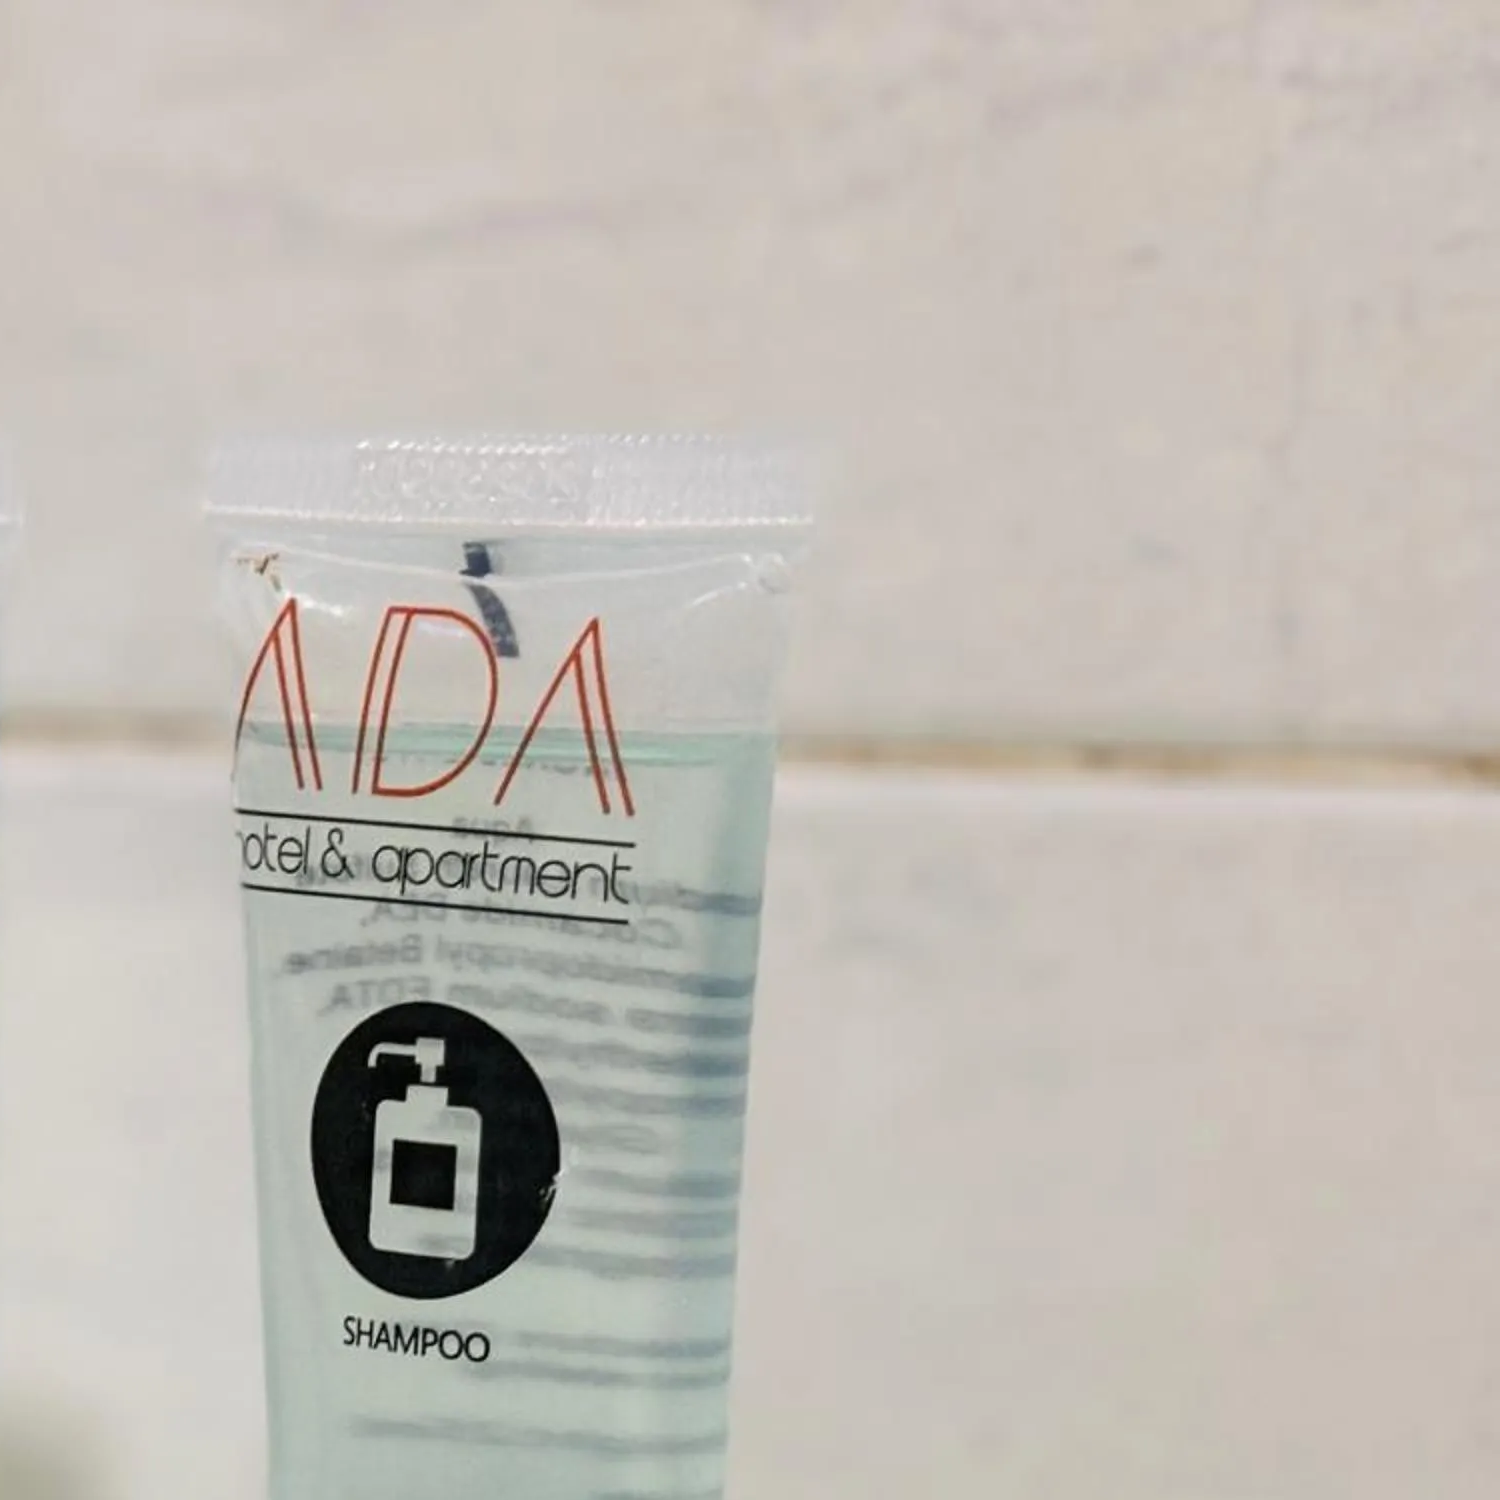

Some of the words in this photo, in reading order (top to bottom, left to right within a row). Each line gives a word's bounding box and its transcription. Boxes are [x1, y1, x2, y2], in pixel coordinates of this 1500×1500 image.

[231, 597, 636, 818] ADA
[321, 827, 355, 879] &
[371, 840, 633, 905] apartment
[342, 1315, 491, 1363] SHAMPOO
